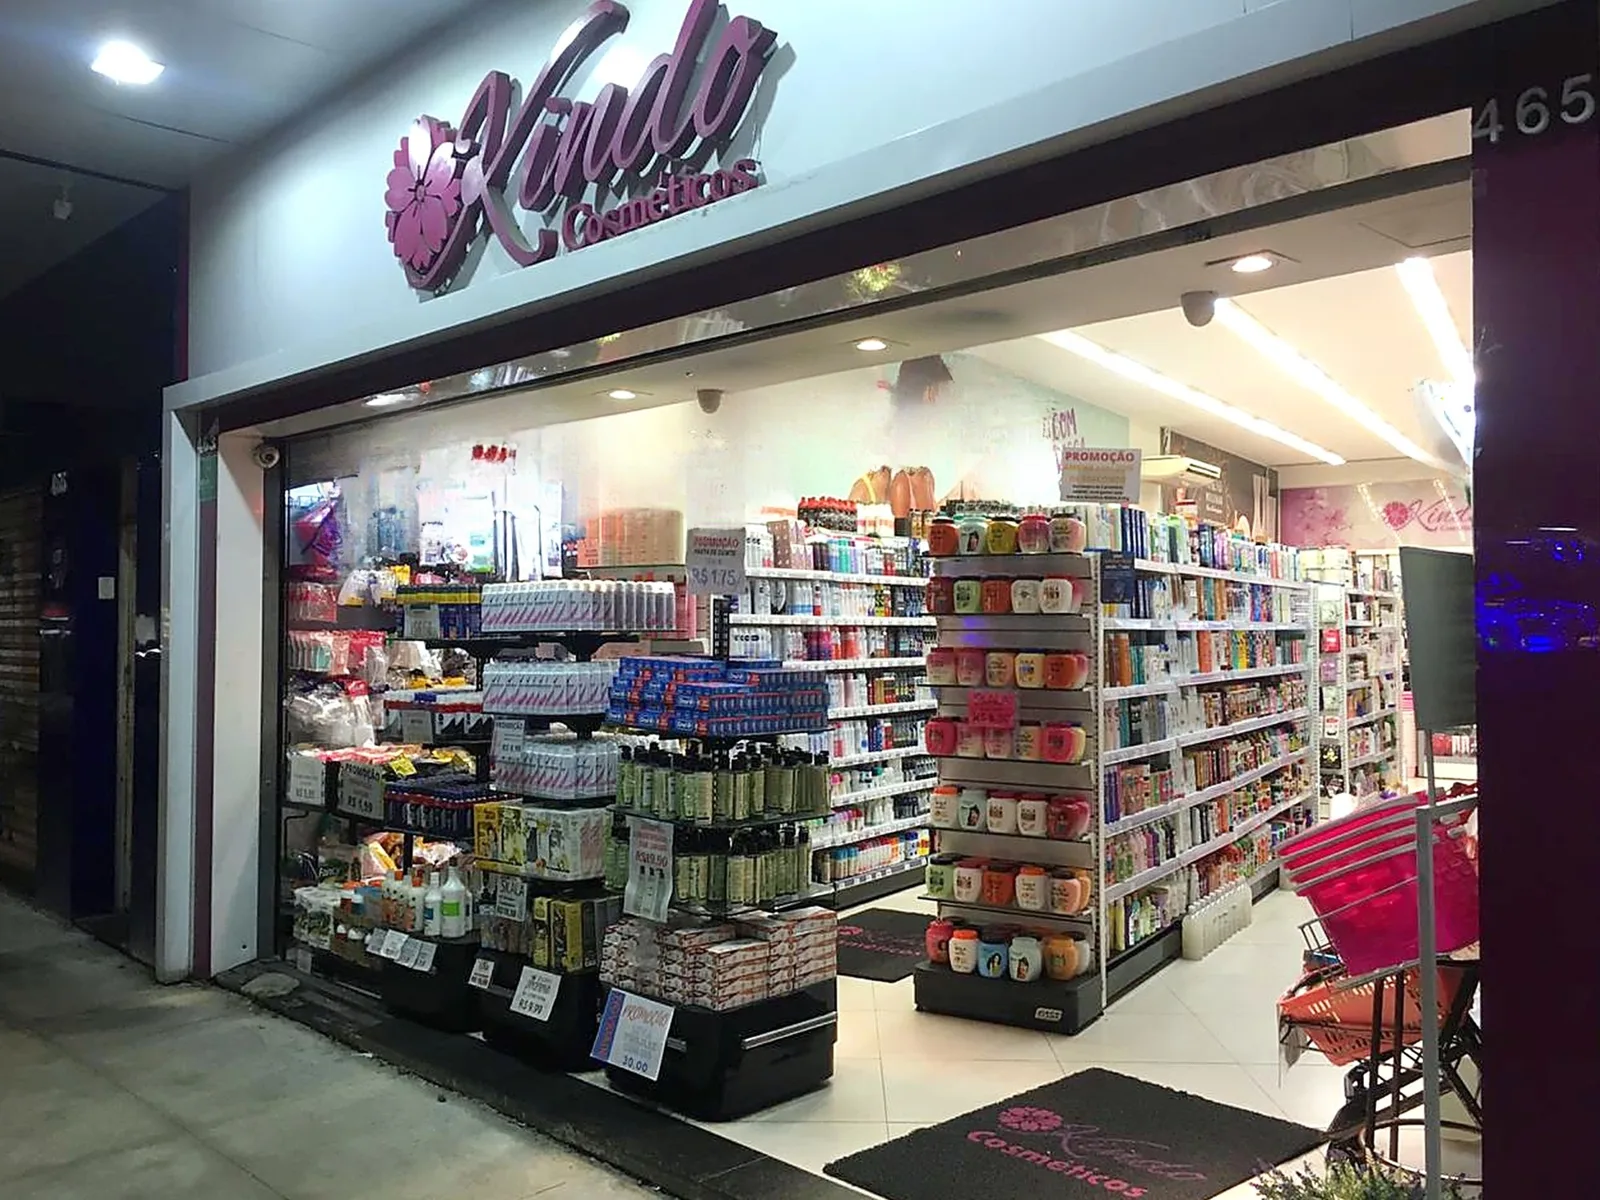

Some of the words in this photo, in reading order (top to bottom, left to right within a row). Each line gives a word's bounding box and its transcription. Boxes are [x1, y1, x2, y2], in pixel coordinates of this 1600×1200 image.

[455, 0, 778, 268] Kindo
[1472, 73, 1595, 142] 465
[562, 158, 763, 252] Cosméticos
[1065, 450, 1135, 464] PROMOÇÃO
